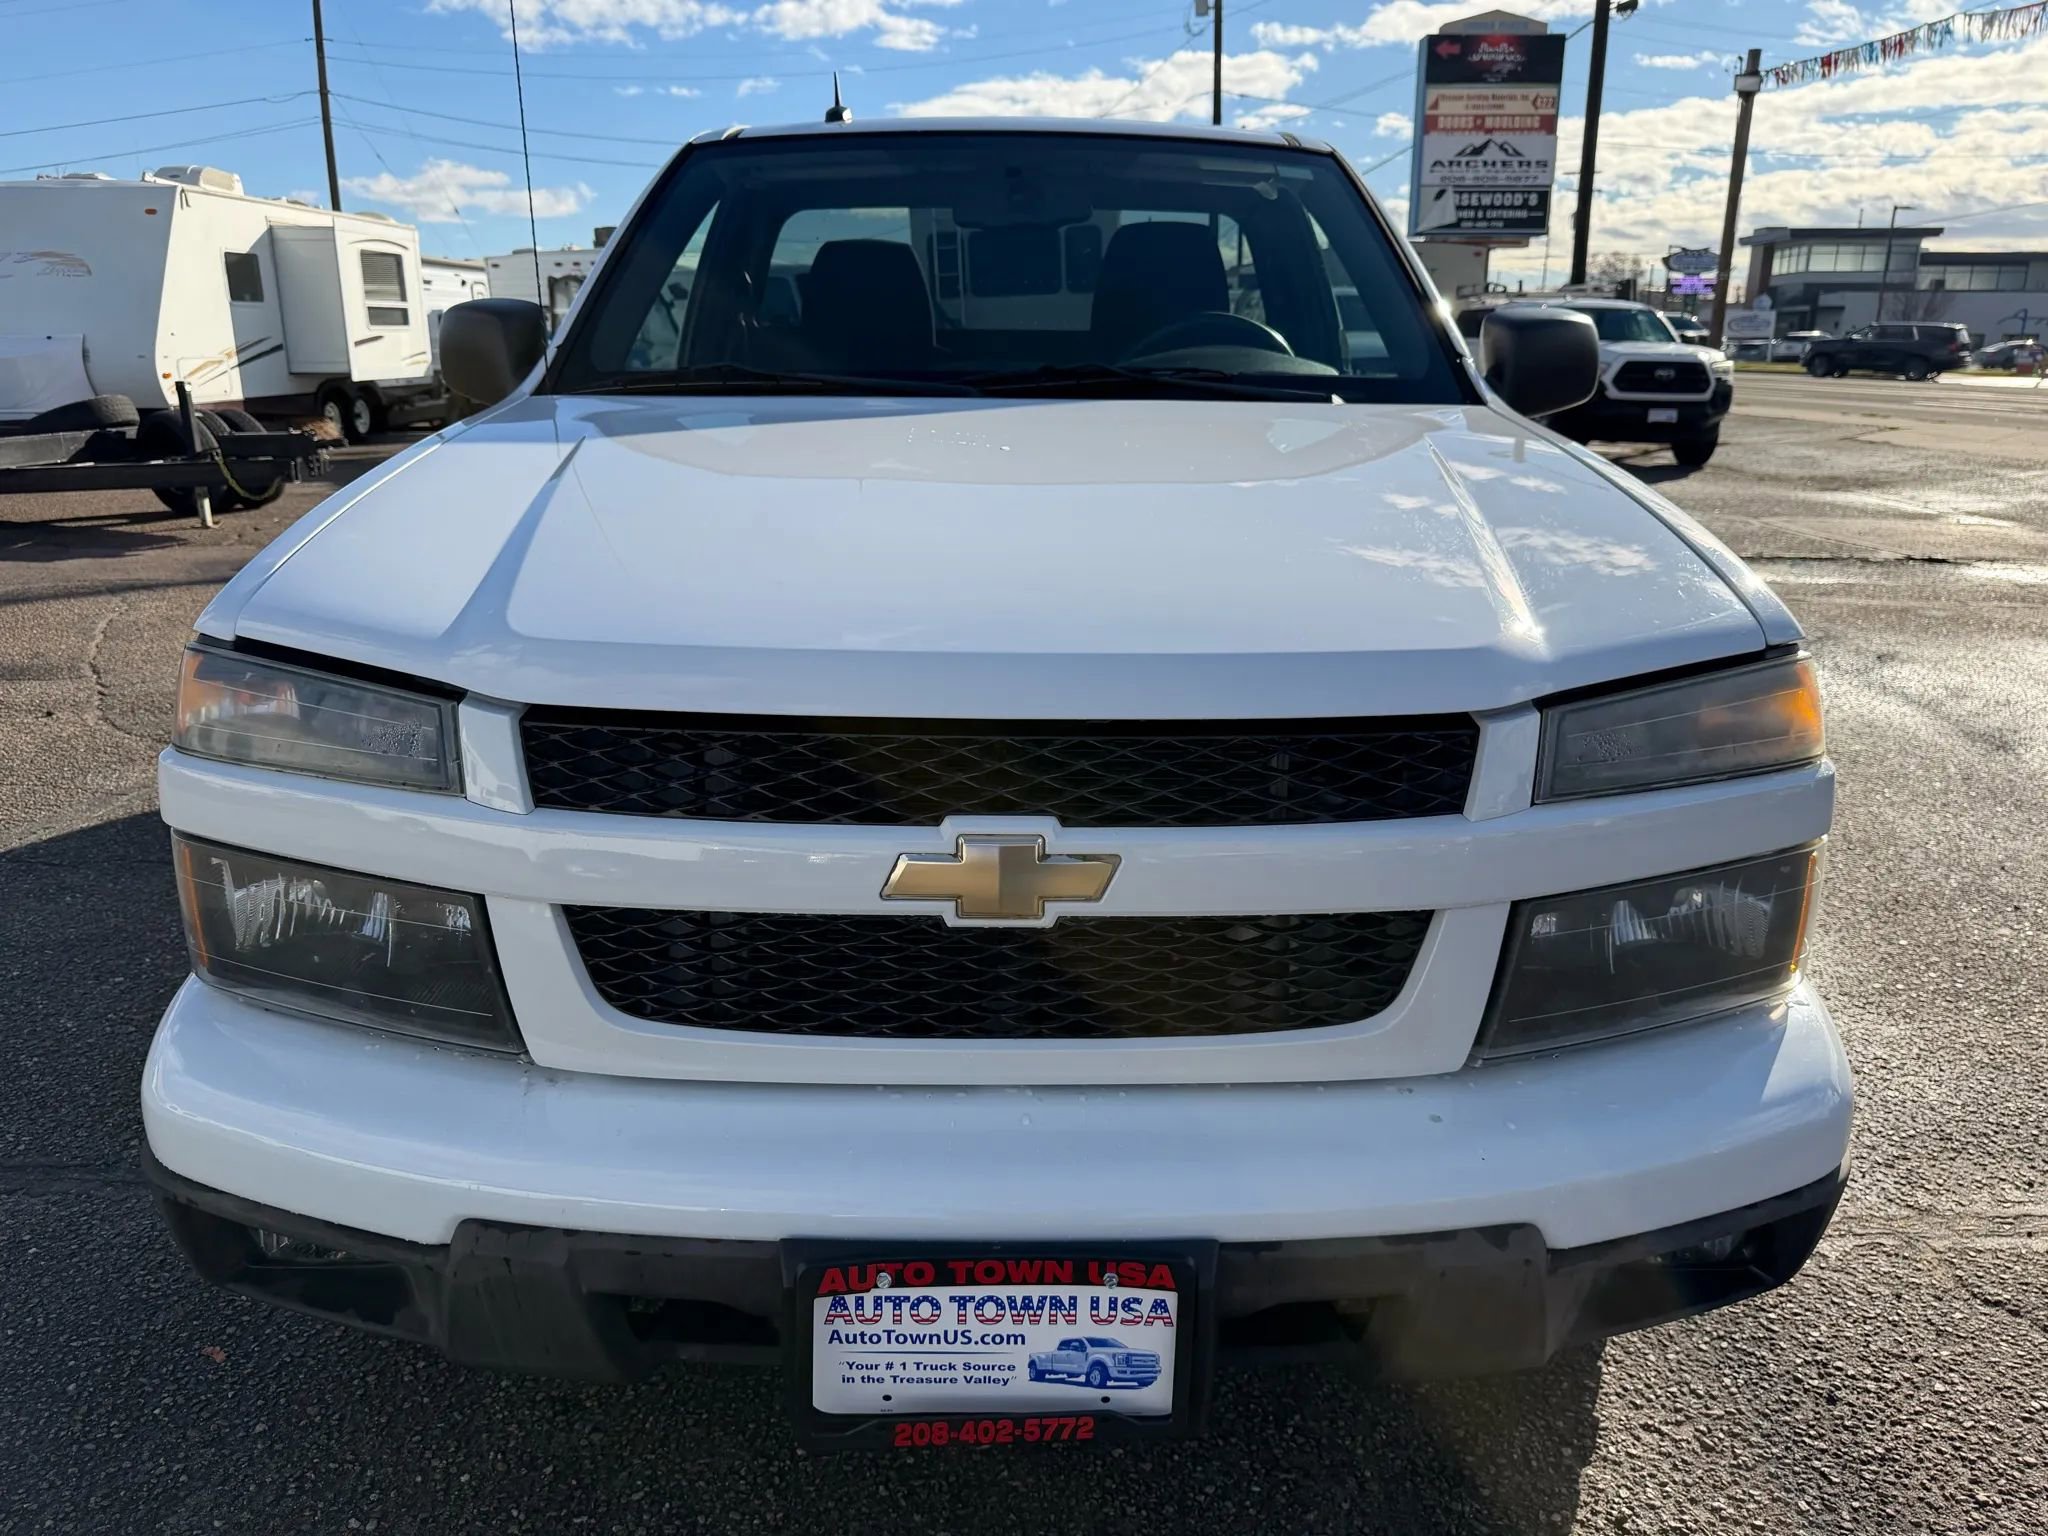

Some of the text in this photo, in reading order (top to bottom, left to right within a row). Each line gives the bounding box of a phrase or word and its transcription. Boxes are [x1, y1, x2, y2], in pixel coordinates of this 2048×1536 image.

[1430, 160, 1549, 169] ARCHERS
[817, 1259, 1176, 1294] AUTO TOWN USA
[824, 1295, 1174, 1327] AUTO TOWN USA
[828, 1329, 1026, 1346] AutoTownUS.com
[885, 1361, 895, 1371] #
[900, 1361, 907, 1371] 1
[913, 1361, 957, 1371] Truck
[962, 1361, 1016, 1372] Source
[841, 1374, 856, 1384] in
[861, 1374, 885, 1384] the
[890, 1374, 958, 1385] Treasure
[894, 1416, 1095, 1447] 208-402-5772
